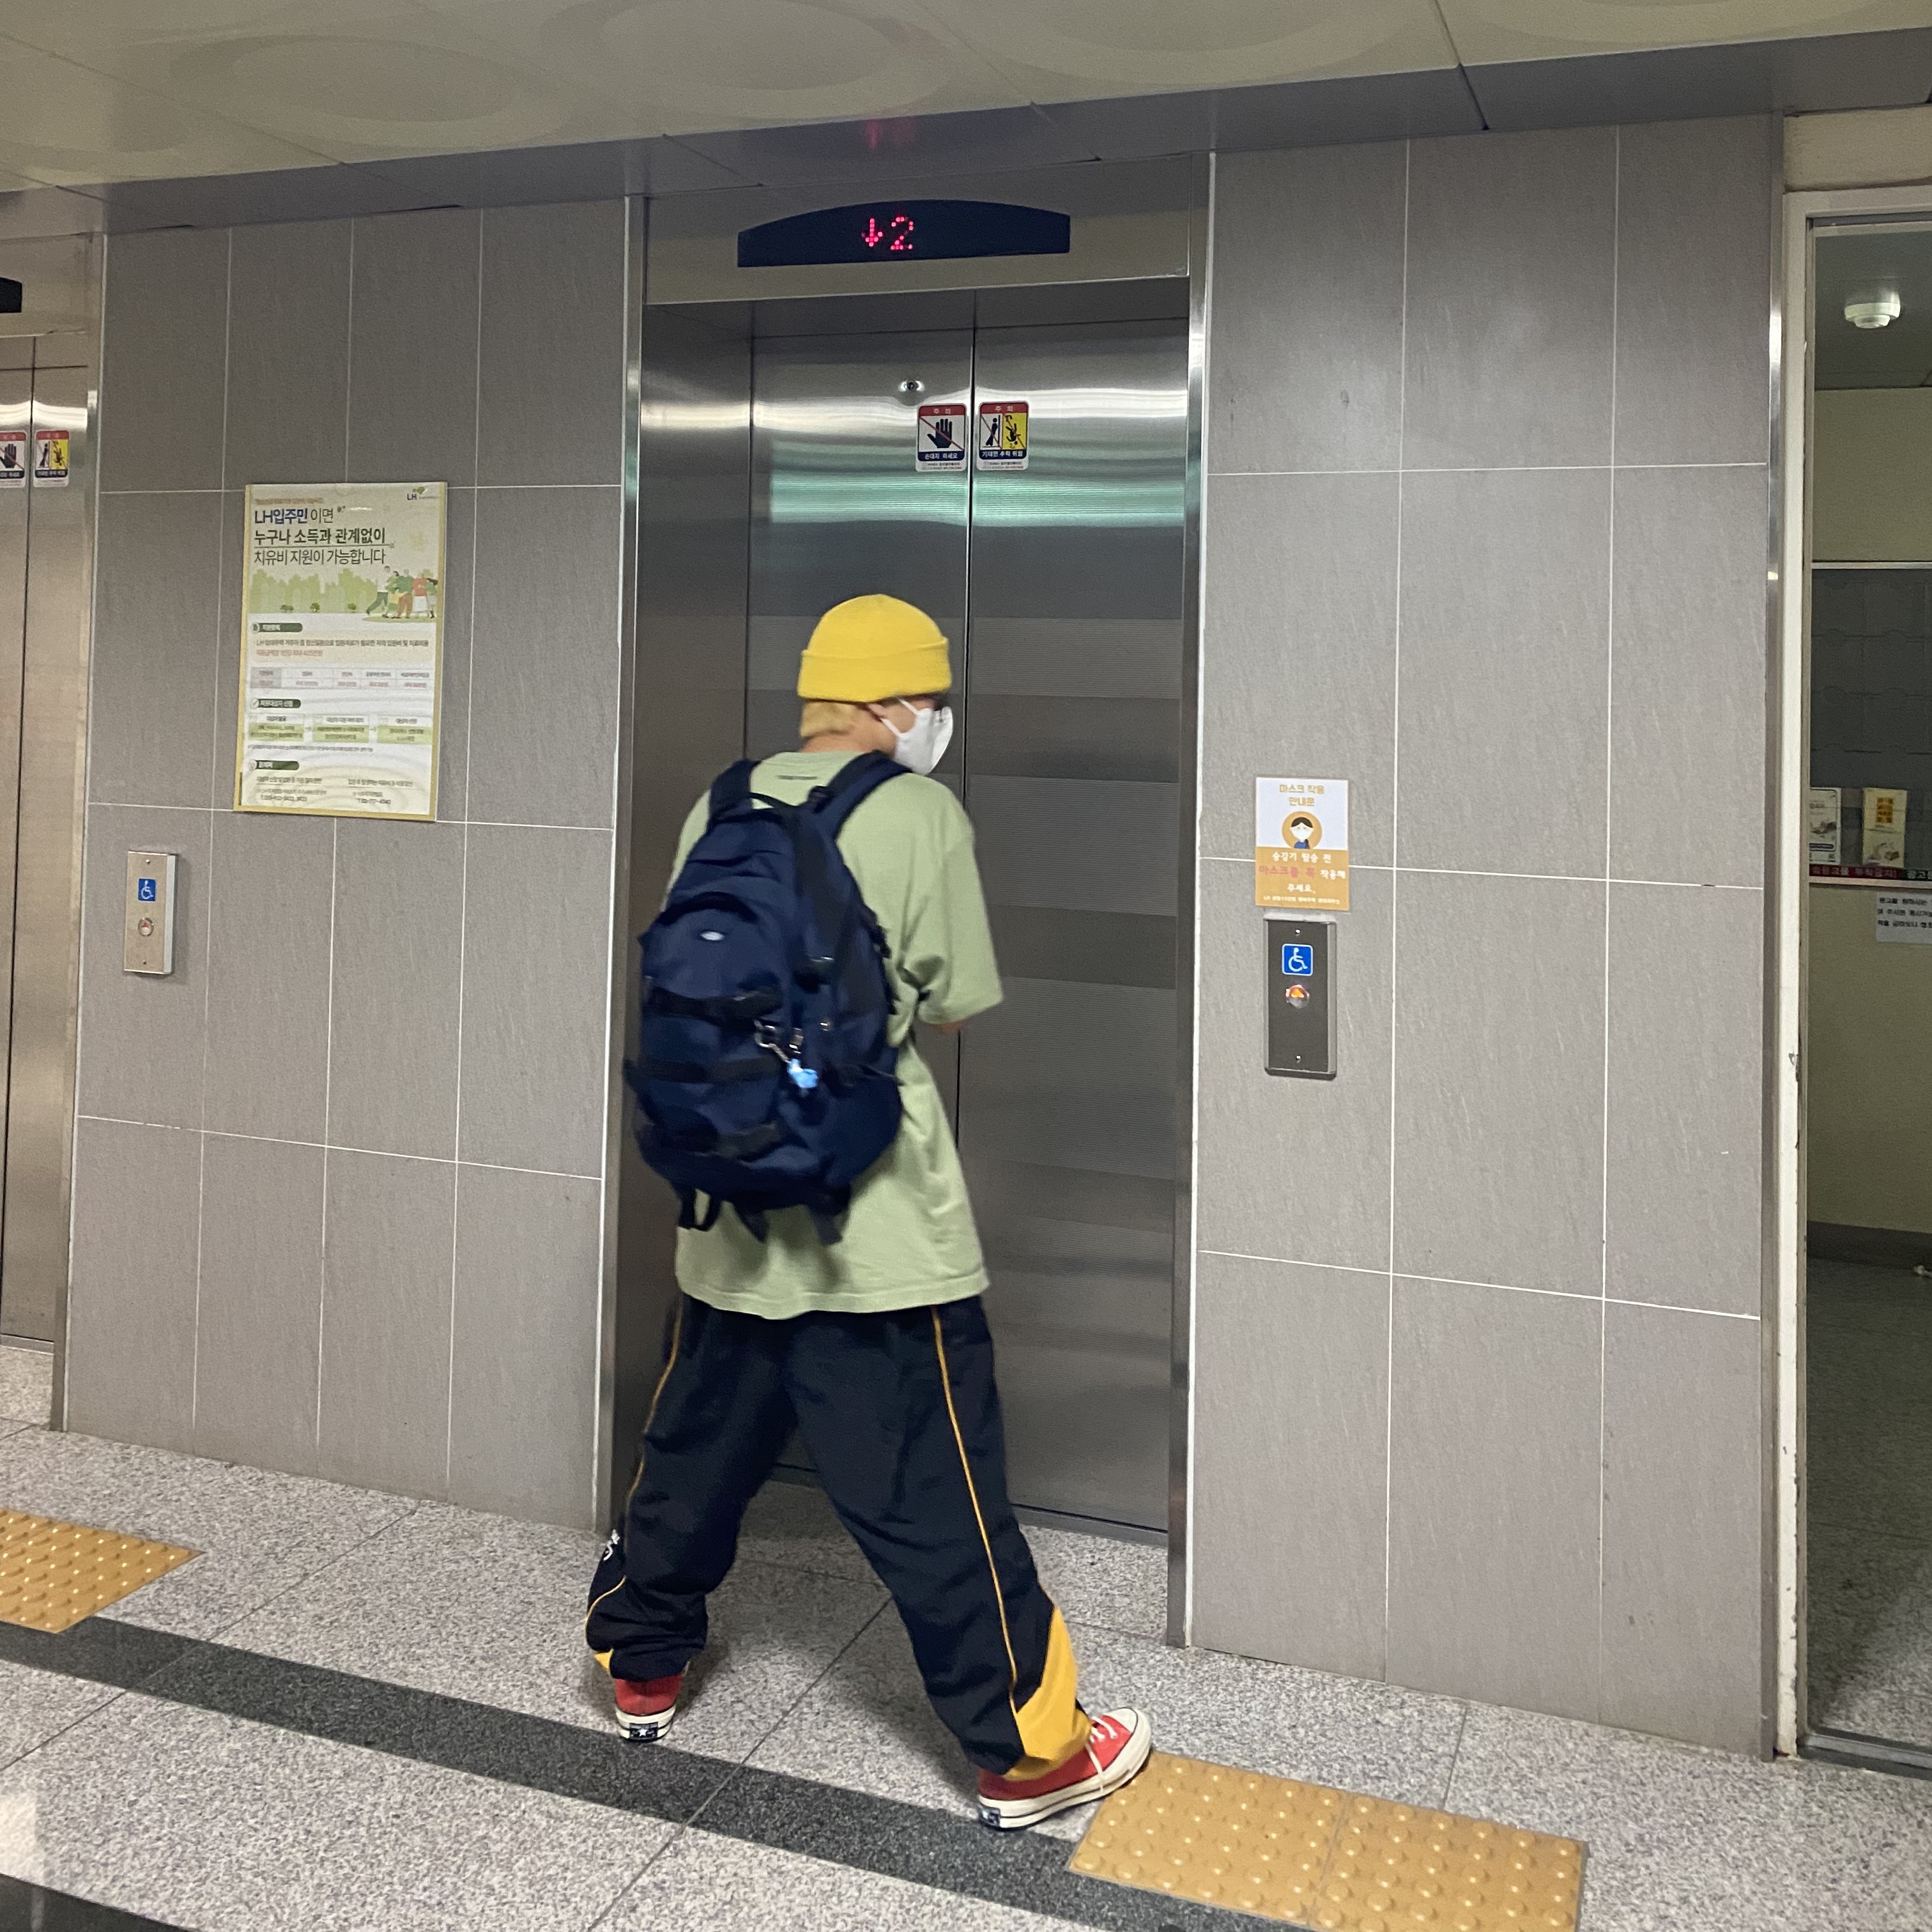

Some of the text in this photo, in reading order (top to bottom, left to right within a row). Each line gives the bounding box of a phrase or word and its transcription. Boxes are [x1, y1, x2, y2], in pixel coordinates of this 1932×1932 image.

[890, 216, 915, 251] 2
[406, 493, 418, 501] LH
[254, 508, 334, 525] LH입주민 이면
[254, 527, 385, 546] 누구나 소득과 관계없이
[254, 548, 387, 566] 치유비 지원이 가능합니다
[1278, 783, 1325, 795] 마스크 착용
[1288, 797, 1315, 807] 안내문
[1272, 851, 1331, 864] 승강기 탑승 전
[1259, 866, 1299, 878] 마스크를
[1320, 869, 1346, 880] 착용해
